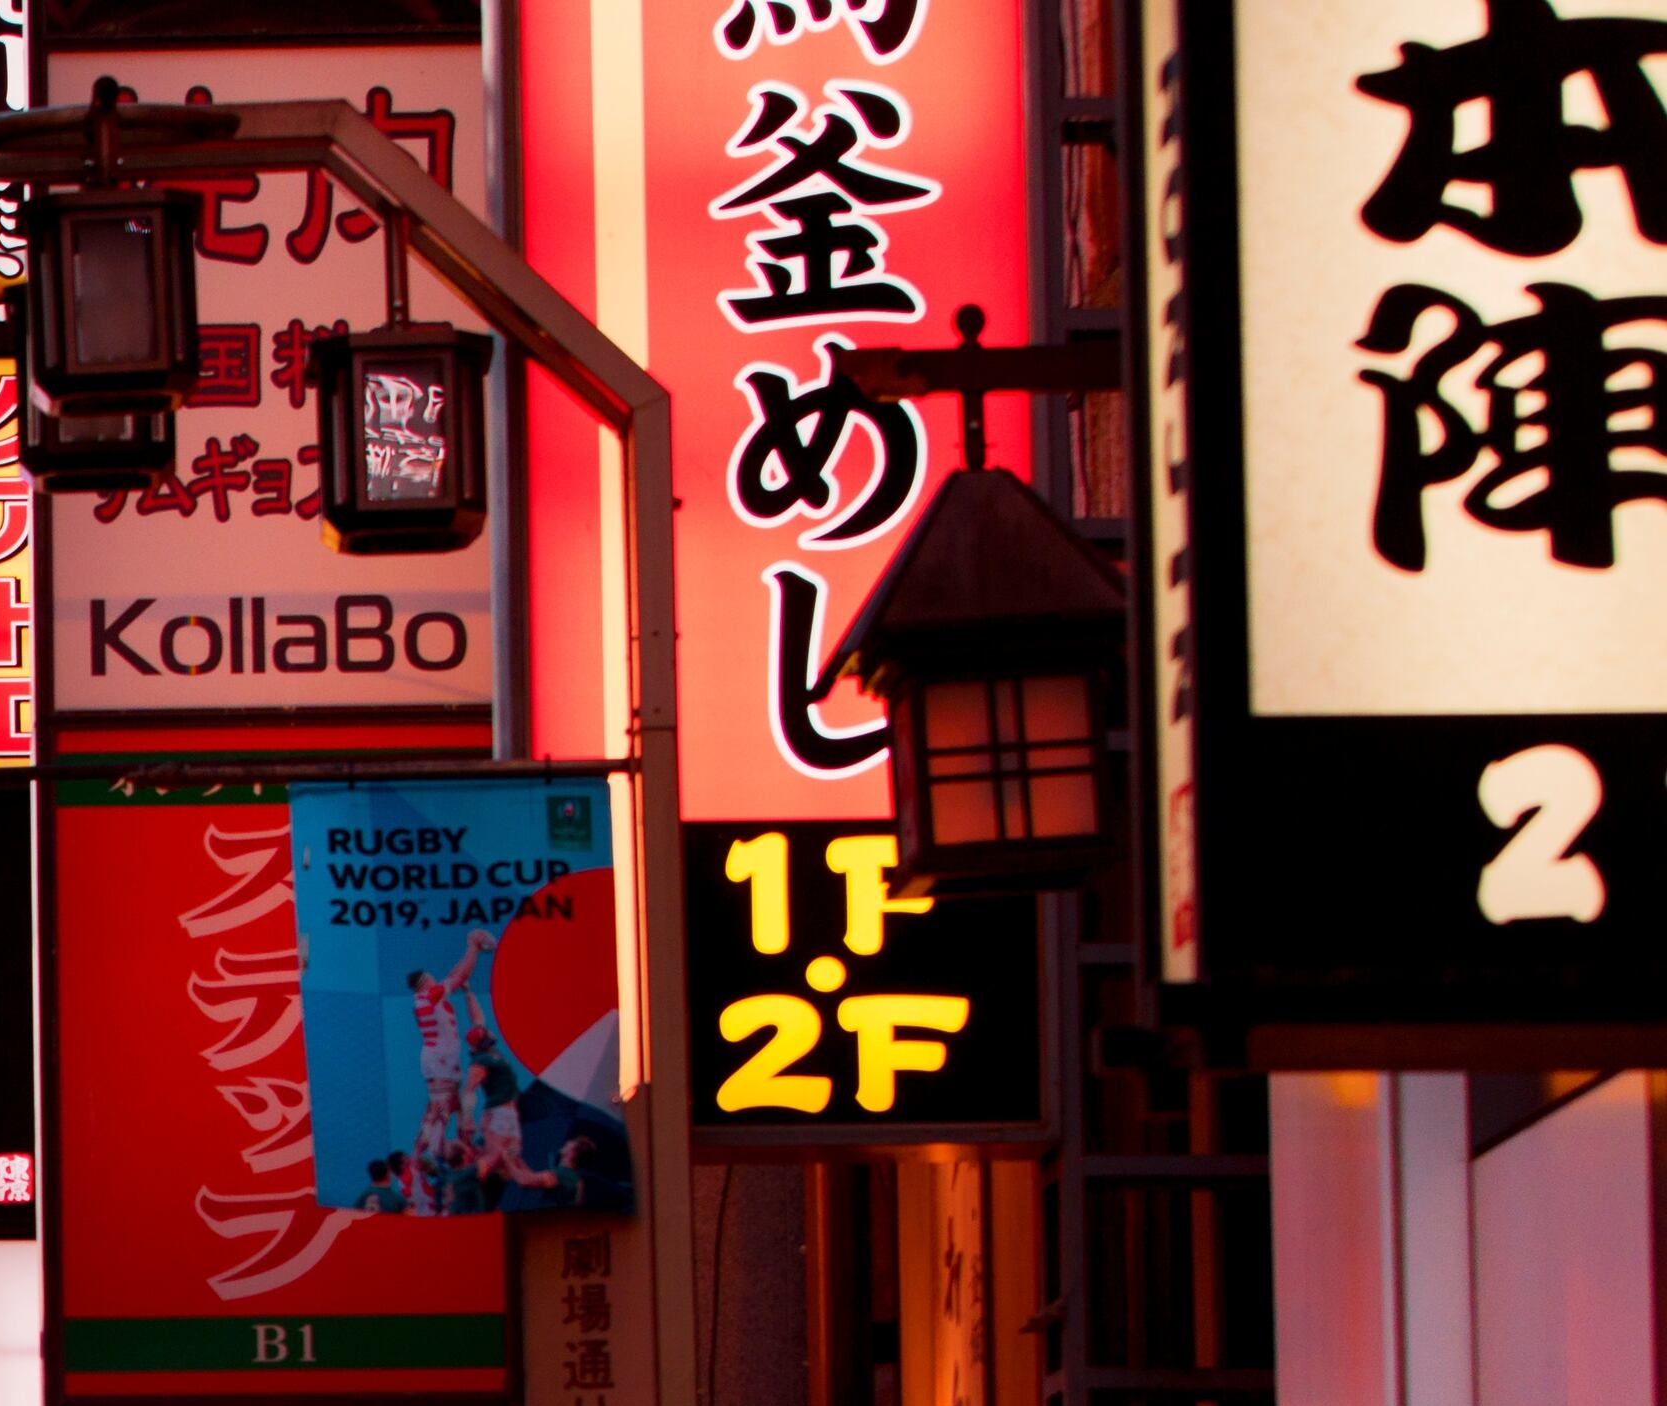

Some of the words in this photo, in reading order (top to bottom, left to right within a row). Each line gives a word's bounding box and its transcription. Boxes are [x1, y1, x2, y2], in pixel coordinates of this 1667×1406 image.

[90, 594, 468, 677] KollaBo
[328, 826, 466, 856] RUGBY
[1477, 744, 1607, 923] 2
[328, 861, 480, 892] WORLD
[487, 860, 571, 888] CUP
[330, 896, 431, 929] 2019,
[439, 893, 574, 926] JAPAN
[715, 993, 970, 1114] 2F
[252, 1324, 317, 1363] B1
